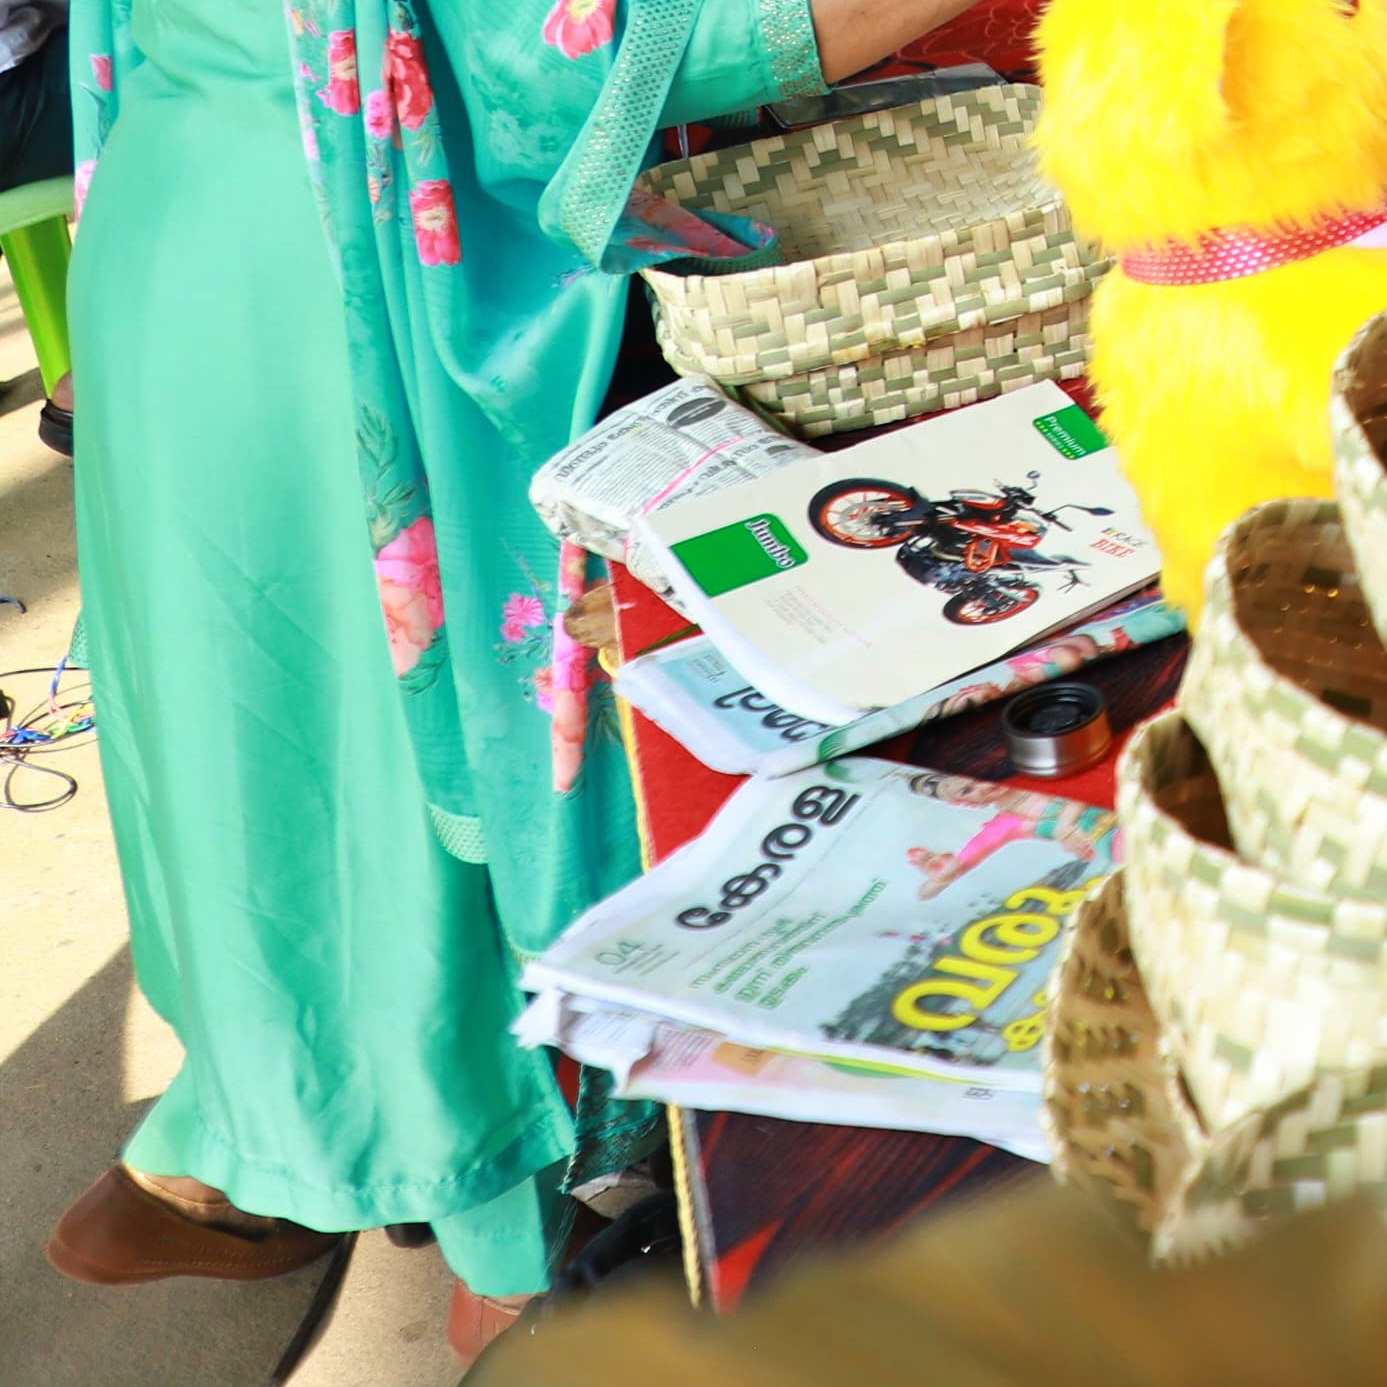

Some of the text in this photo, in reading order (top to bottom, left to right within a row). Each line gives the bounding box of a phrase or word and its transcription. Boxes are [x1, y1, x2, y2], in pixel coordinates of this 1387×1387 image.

[1046, 416, 1087, 456] Premium
[745, 518, 795, 569] Jumbo
[1090, 538, 1136, 559] BIKE
